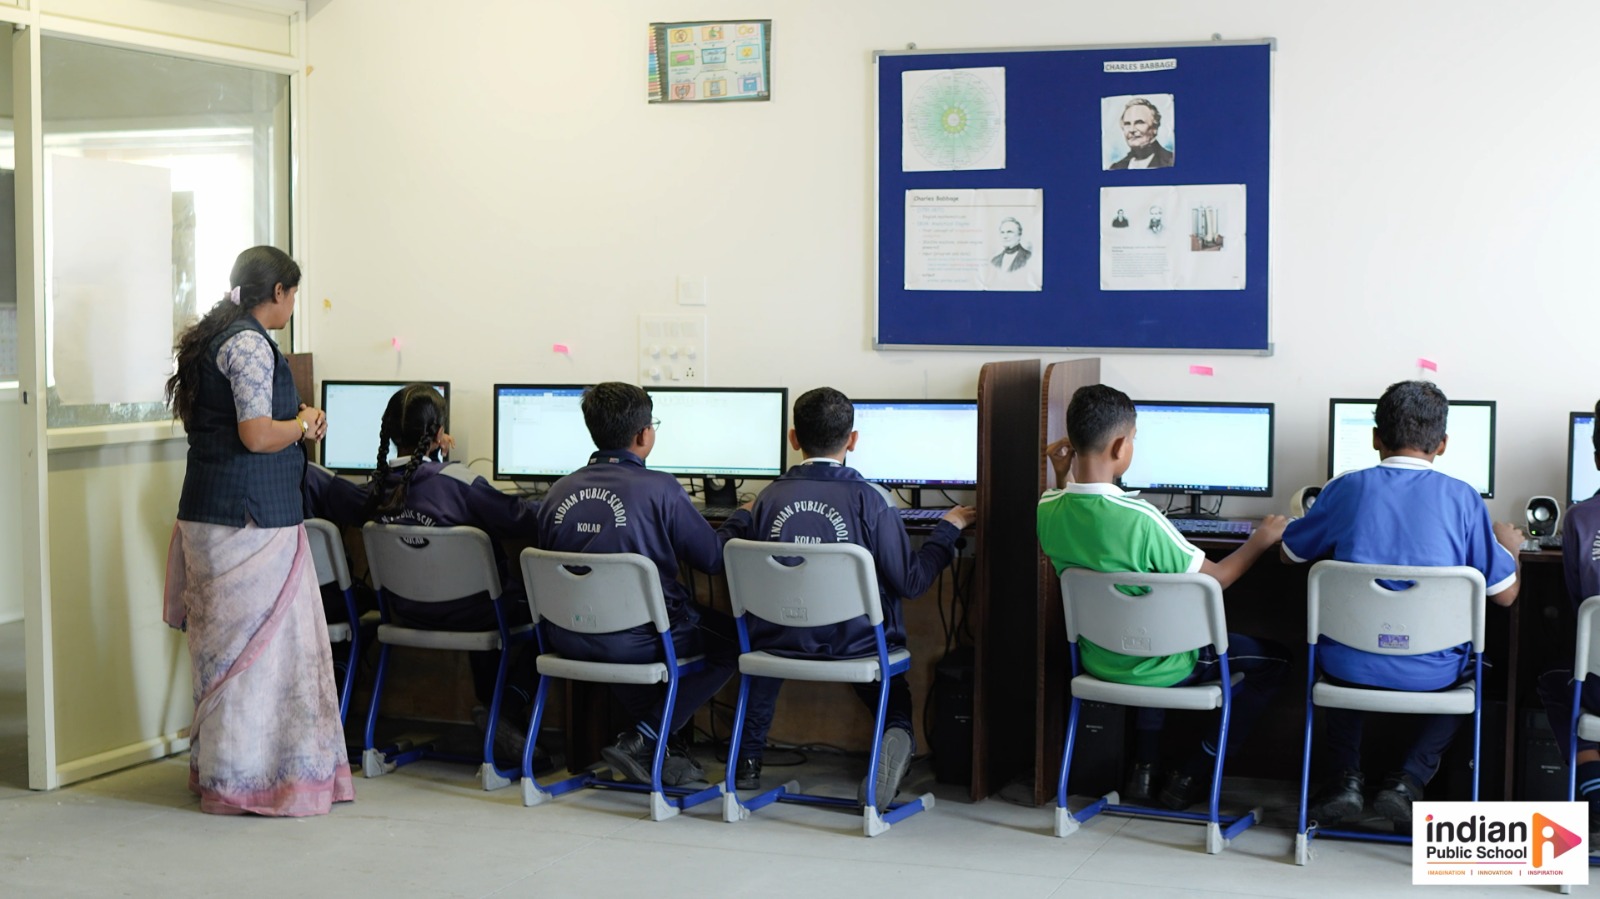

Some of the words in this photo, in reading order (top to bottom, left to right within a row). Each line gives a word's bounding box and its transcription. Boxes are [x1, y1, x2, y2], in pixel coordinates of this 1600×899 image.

[1105, 63, 1138, 71] CHARLES
[1139, 60, 1175, 70] BABBAGE
[936, 195, 959, 203] Babbage
[554, 493, 579, 524] INDIAN
[579, 487, 611, 502] PUBLIC
[607, 494, 627, 528] SCHOOL
[770, 505, 794, 538] INDIAN
[794, 500, 828, 515] PUBLIC
[825, 507, 849, 542] SCHOOL
